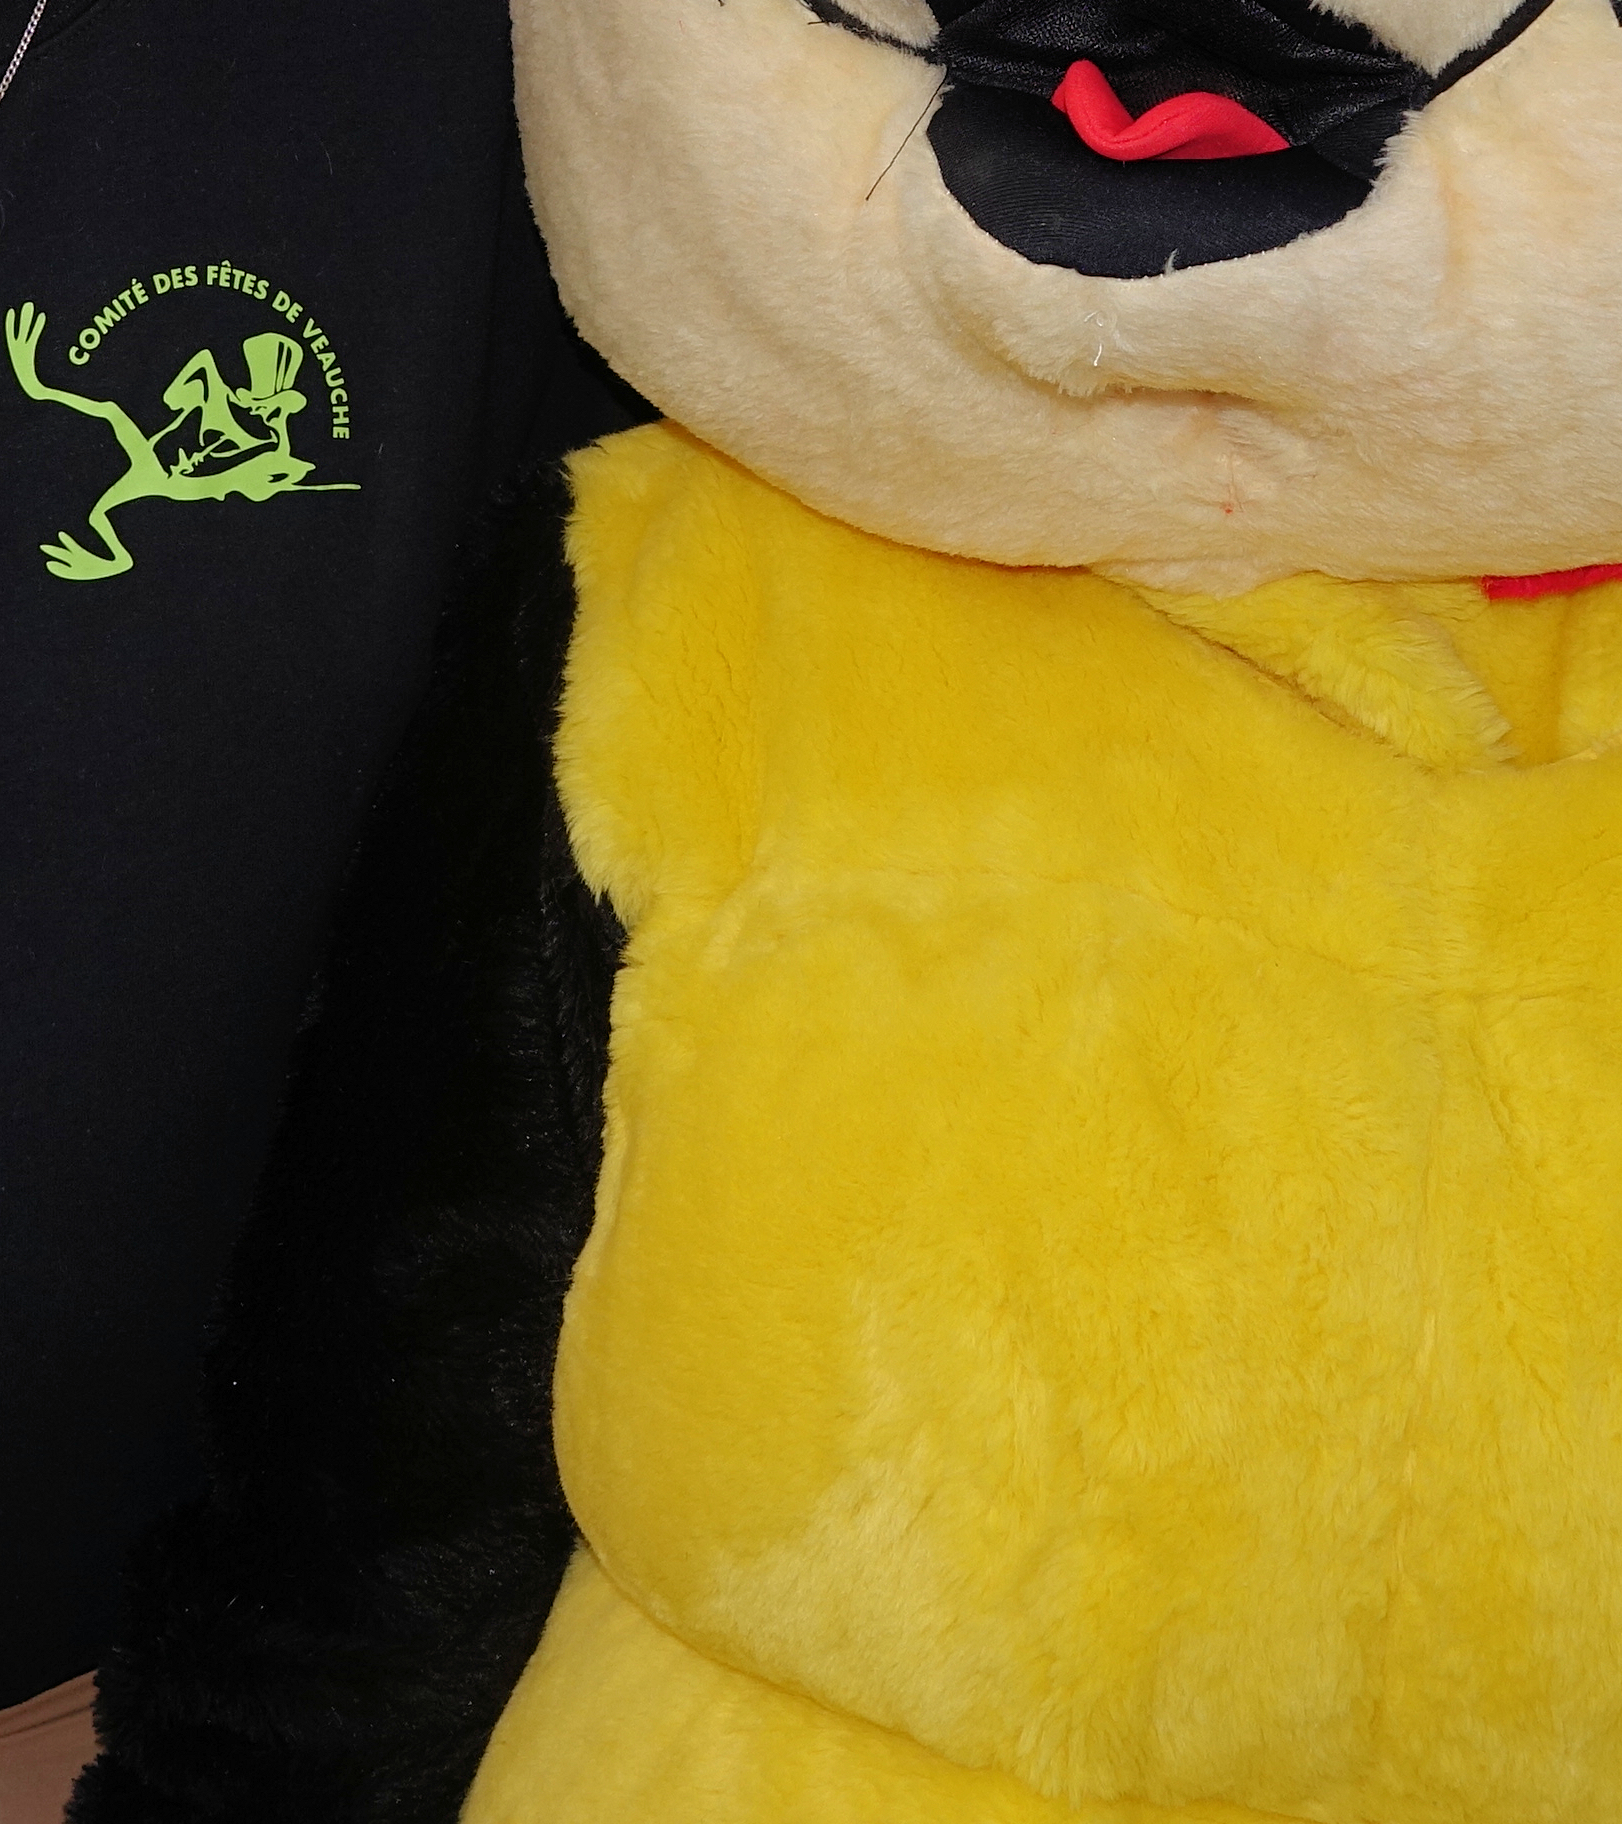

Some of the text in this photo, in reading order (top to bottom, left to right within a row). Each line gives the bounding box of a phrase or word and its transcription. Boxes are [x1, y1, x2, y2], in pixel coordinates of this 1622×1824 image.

[68, 259, 351, 441] COMITÉ DES FÊTES DE VEAUCHE
